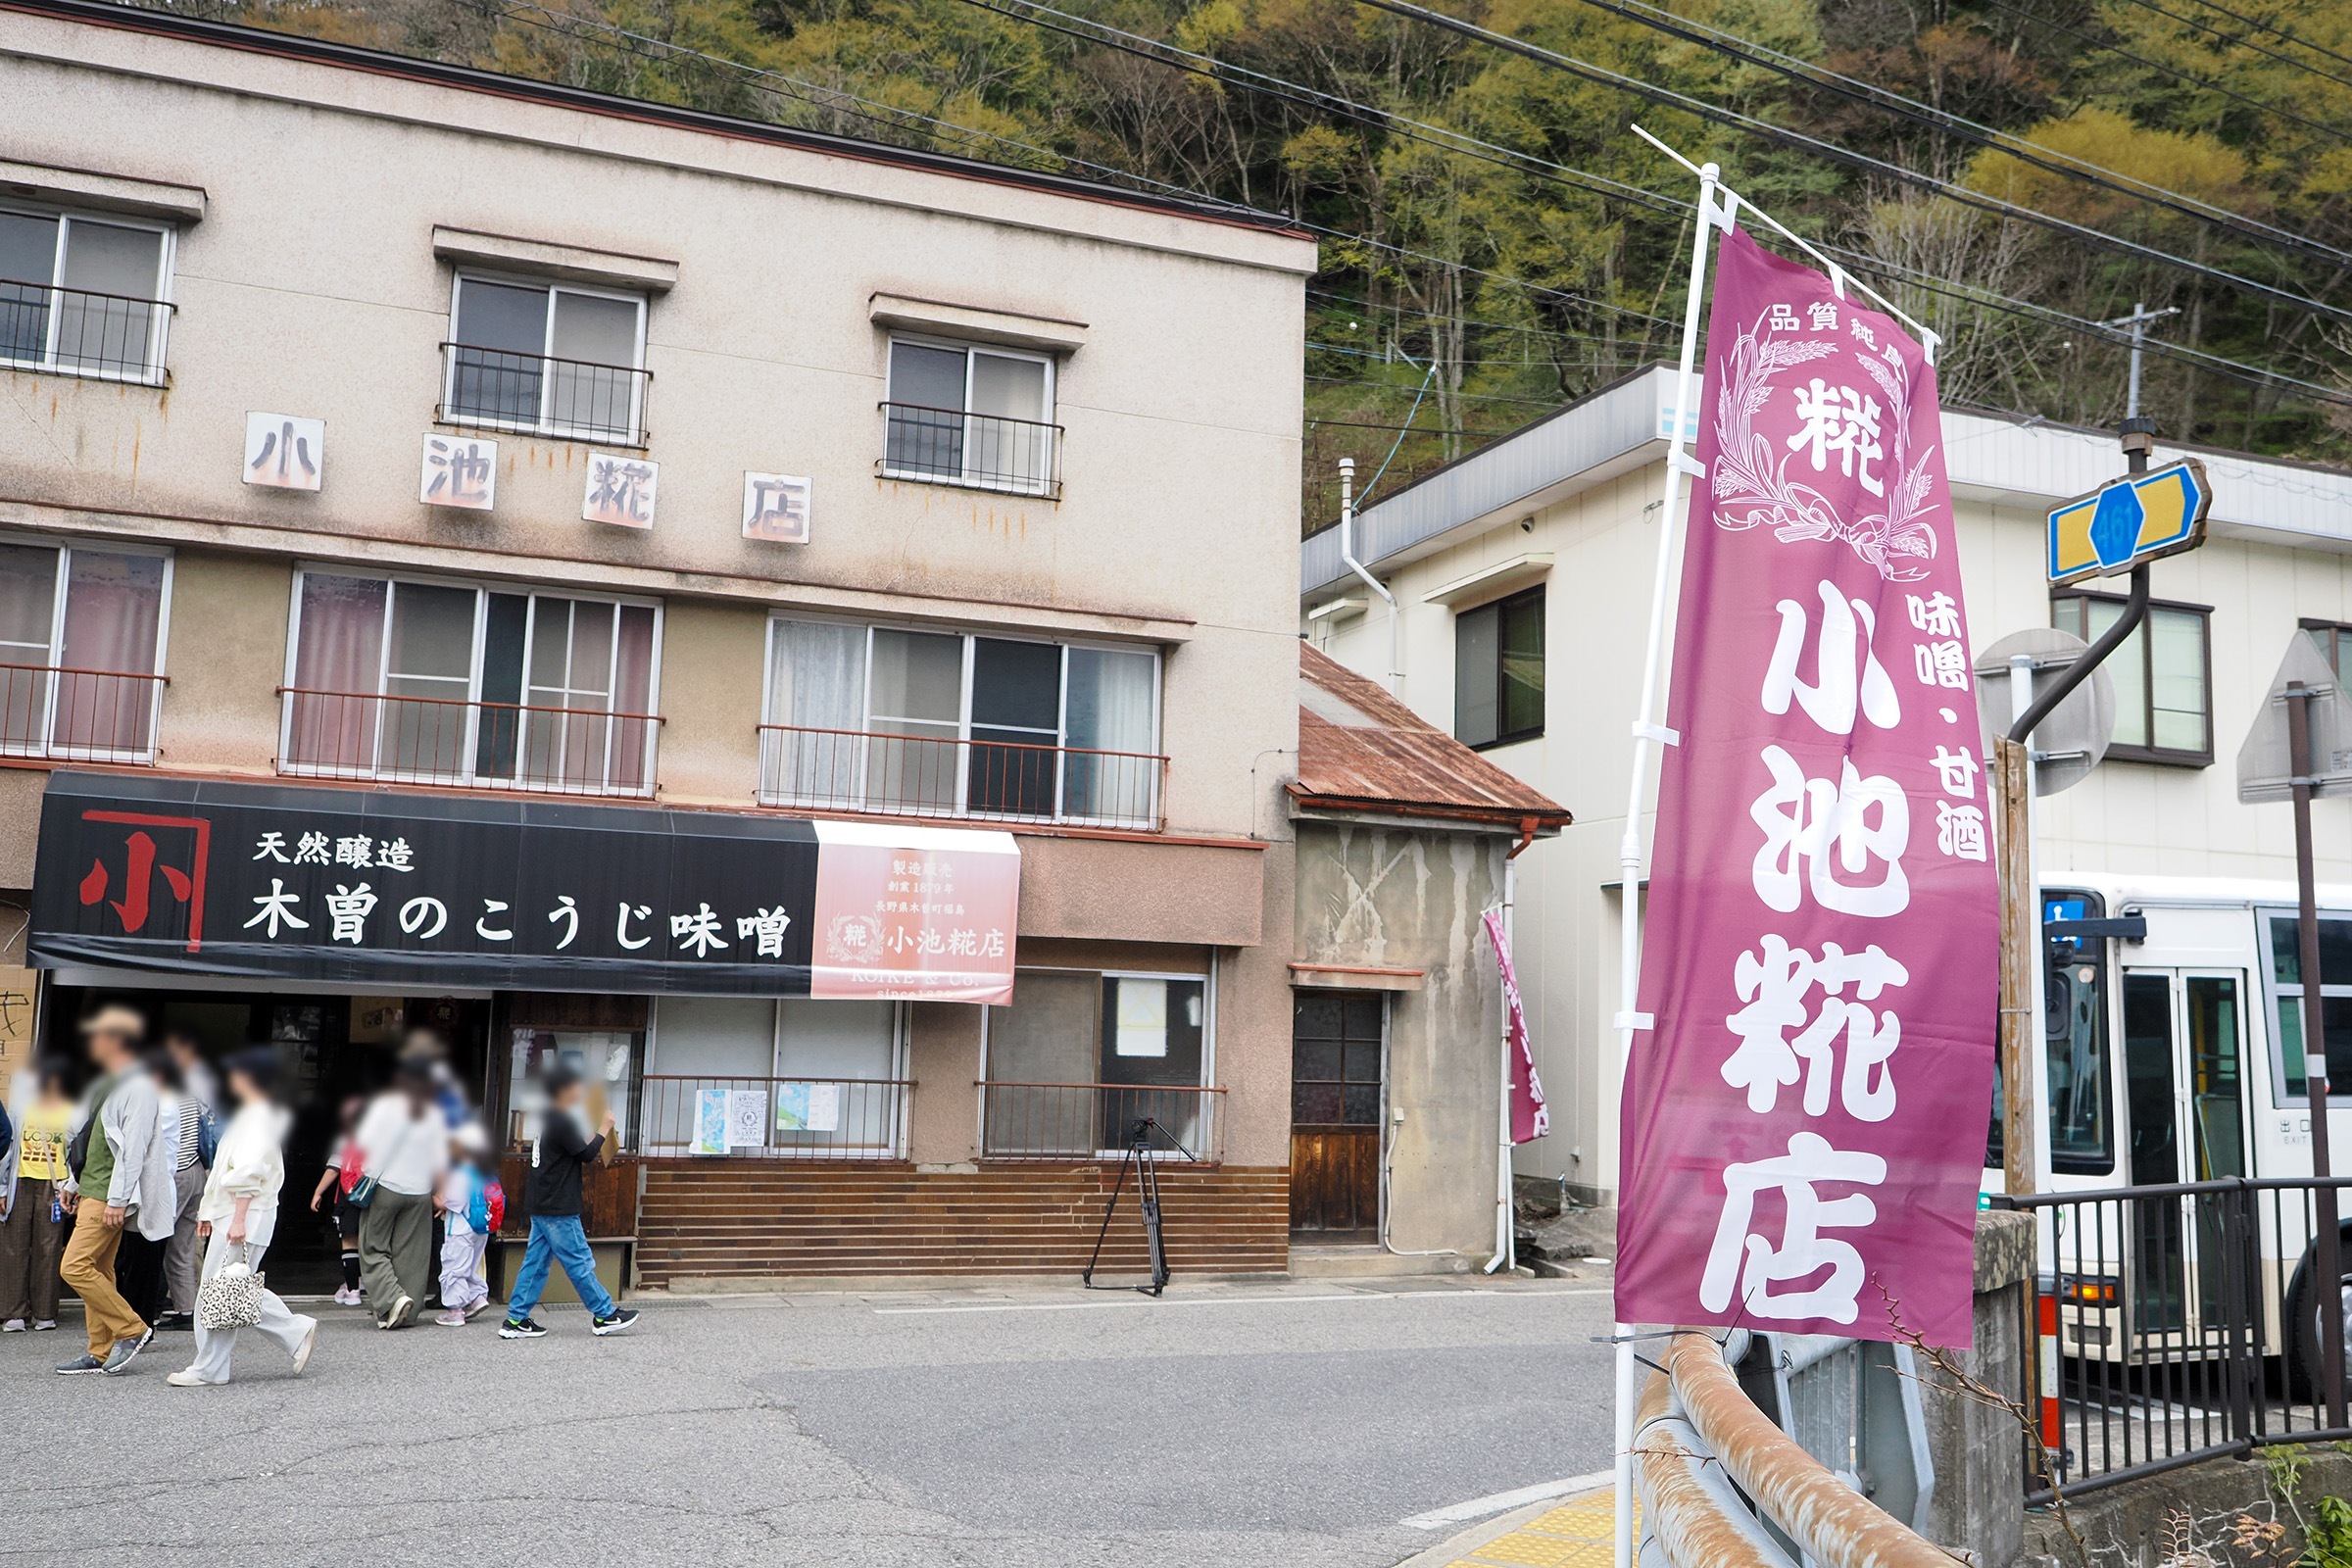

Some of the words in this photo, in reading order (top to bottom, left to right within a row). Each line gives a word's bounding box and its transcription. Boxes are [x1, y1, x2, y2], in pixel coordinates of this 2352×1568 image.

[1787, 377, 1885, 498] 糀
[2096, 501, 2134, 548] 461
[252, 830, 416, 873] 天然醸造
[892, 858, 954, 879] 製造販売
[242, 877, 793, 959] 木曽のこうじ味噌
[887, 925, 1005, 958] 小池糀店
[1698, 578, 1911, 1325] 小池糀店
[851, 970, 915, 985] KOIKE
[924, 972, 940, 986] &
[949, 972, 980, 987] Co.
[2283, 1136, 2307, 1145] EXIT
